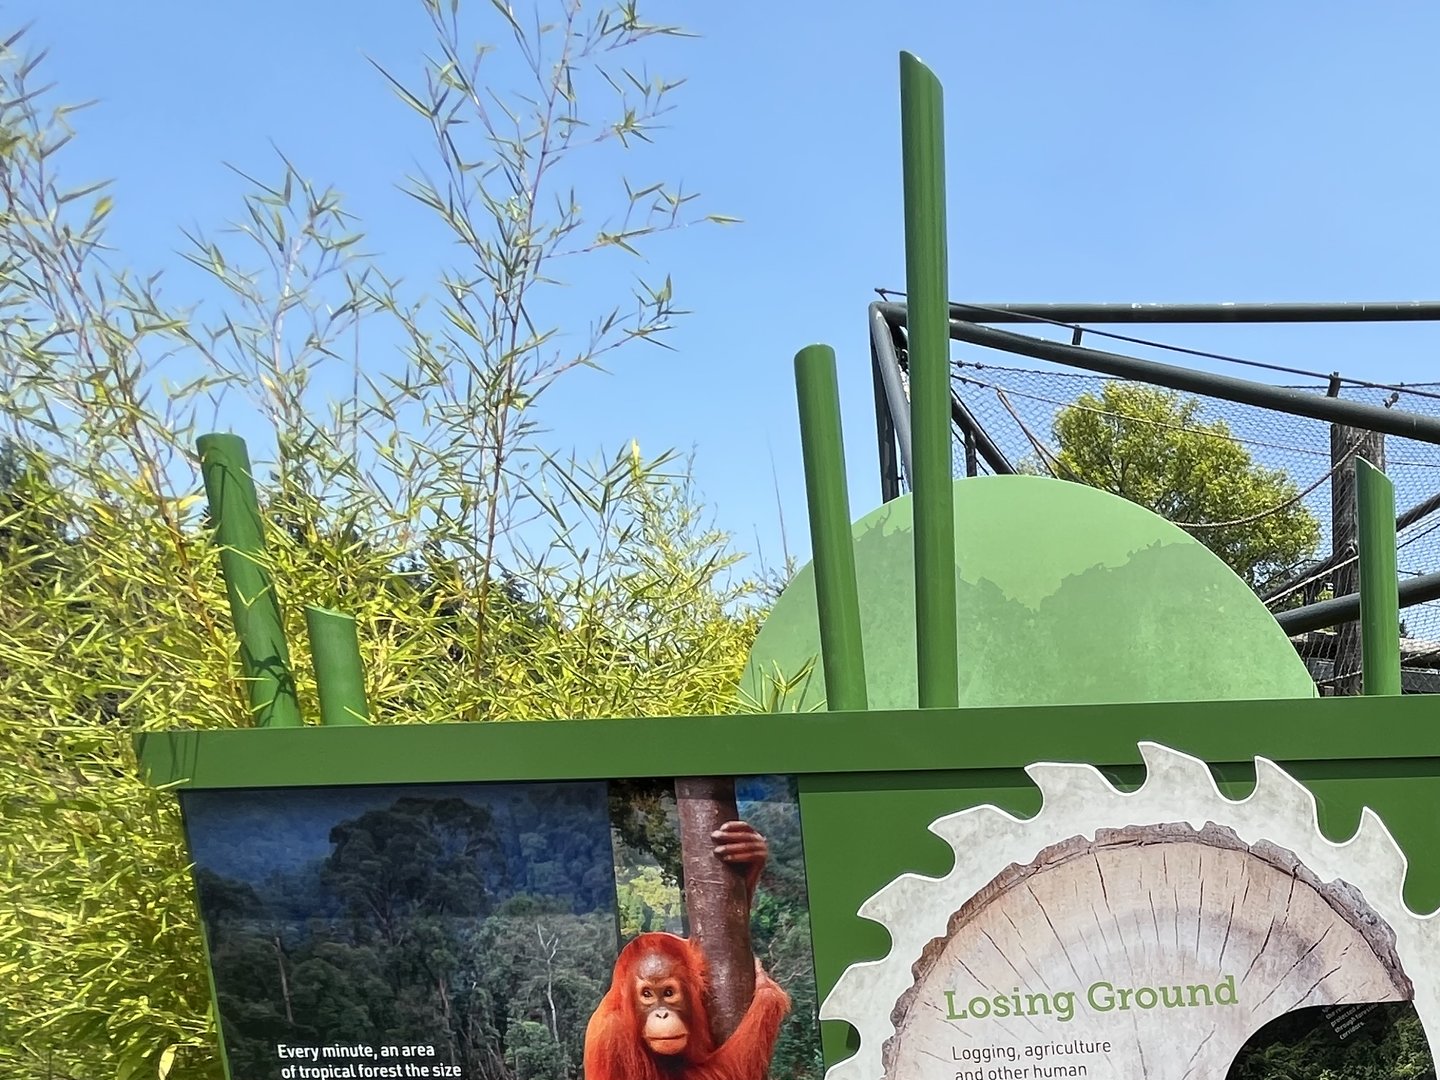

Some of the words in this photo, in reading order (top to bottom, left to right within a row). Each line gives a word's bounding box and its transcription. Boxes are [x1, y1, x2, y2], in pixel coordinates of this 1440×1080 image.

[944, 987, 1075, 1022] Losing
[1087, 975, 1239, 1012] Ground
[277, 1044, 319, 1061] Every
[323, 1044, 378, 1060] minute,
[380, 1045, 399, 1057] an
[402, 1045, 435, 1057] area
[952, 1044, 1022, 1063] Logging,
[1024, 1040, 1112, 1061] agriculture
[281, 1065, 297, 1078] of
[300, 1064, 356, 1080] tropical
[358, 1064, 403, 1078] forest
[405, 1064, 429, 1077] the
[432, 1063, 461, 1077] size
[988, 1066, 1029, 1080] other
[1033, 1064, 1087, 1078] human
